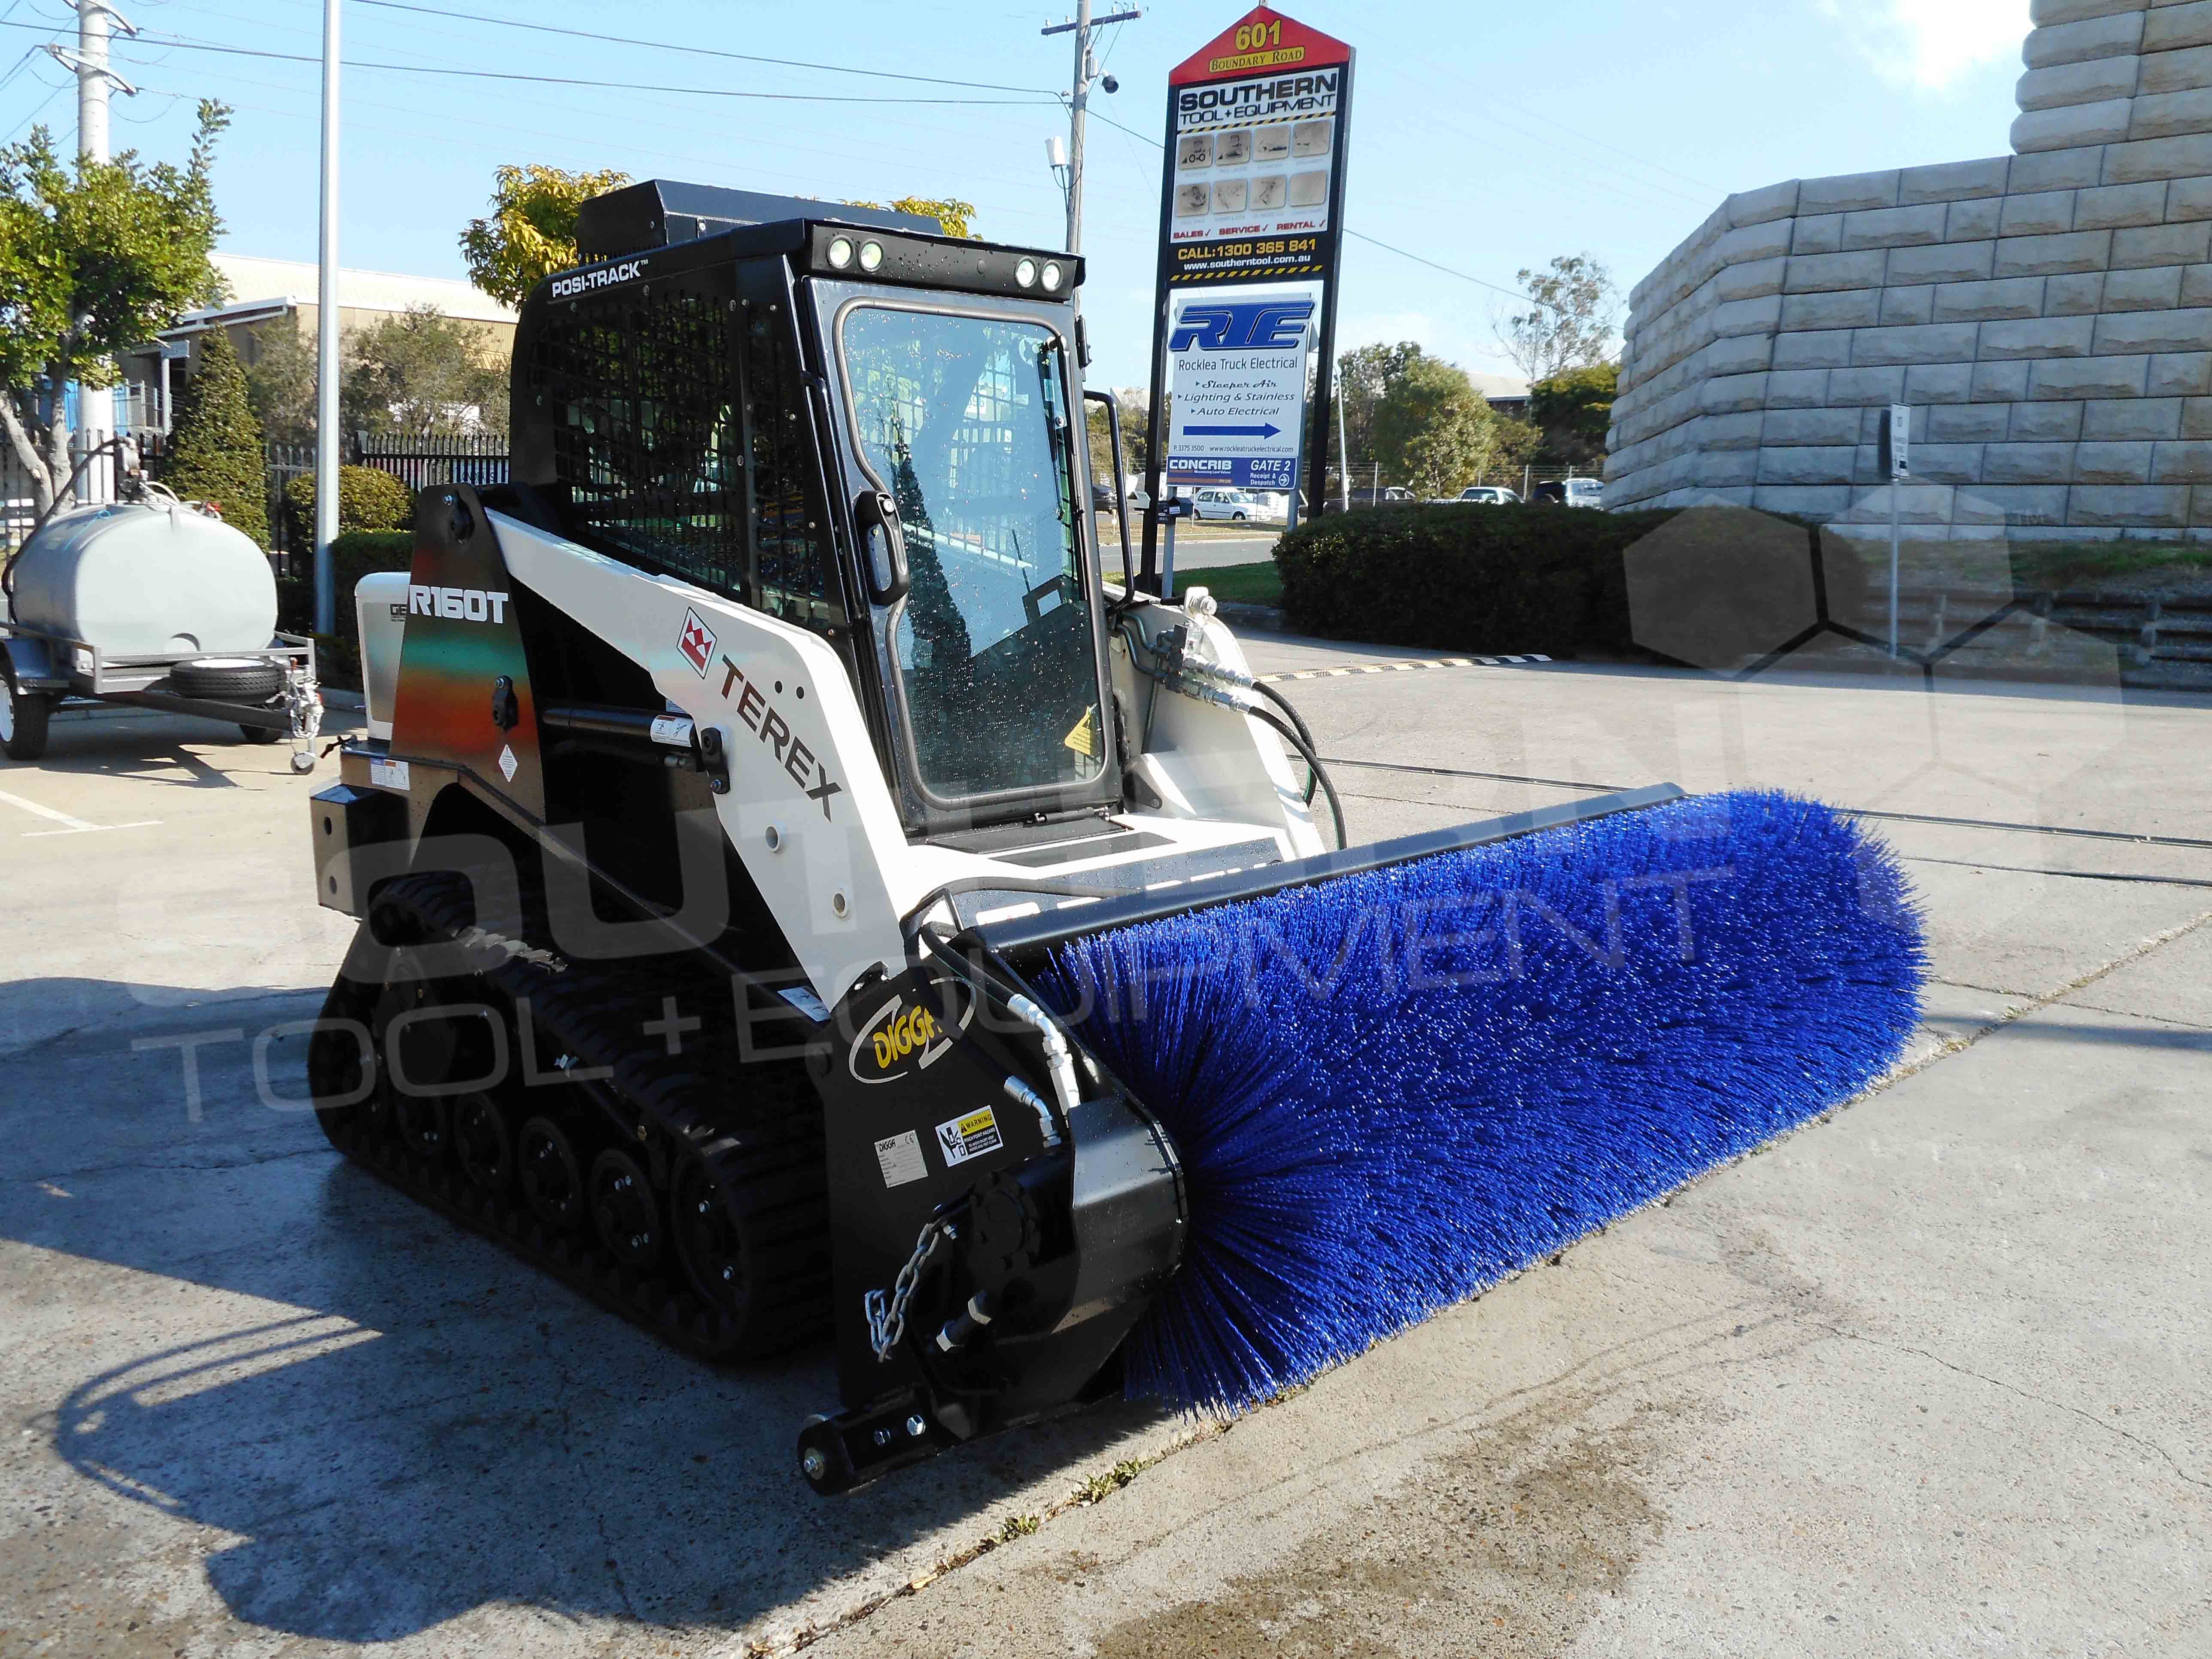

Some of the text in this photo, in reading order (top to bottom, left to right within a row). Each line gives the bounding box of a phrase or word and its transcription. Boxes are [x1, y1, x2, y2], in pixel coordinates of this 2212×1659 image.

[1235, 19, 1282, 51] 601
[1211, 50, 1302, 70] BOUNDARY ROAD
[1180, 73, 1337, 111] SOUTHERN
[1173, 221, 1316, 239] SALES SERVICE RENTAL
[1256, 241, 1285, 254] 365
[1288, 238, 1316, 252] 841
[1184, 255, 1310, 270] www.southerntool.com.au
[1168, 300, 1316, 351] RTE
[1179, 356, 1297, 371] Rocklea Truck Electrical
[1202, 380, 1277, 389] Sleeper Air
[1184, 393, 1231, 403] Lighting
[1245, 392, 1295, 401] Stainless
[1228, 407, 1280, 415] Electrical
[1170, 459, 1232, 470] CONCRIB
[1251, 460, 1291, 471] GATE 2
[409, 585, 509, 623] R160T
[721, 654, 842, 823] TEREX
[966, 1114, 992, 1129] WARNING
[879, 1138, 896, 1152] DIGGA
